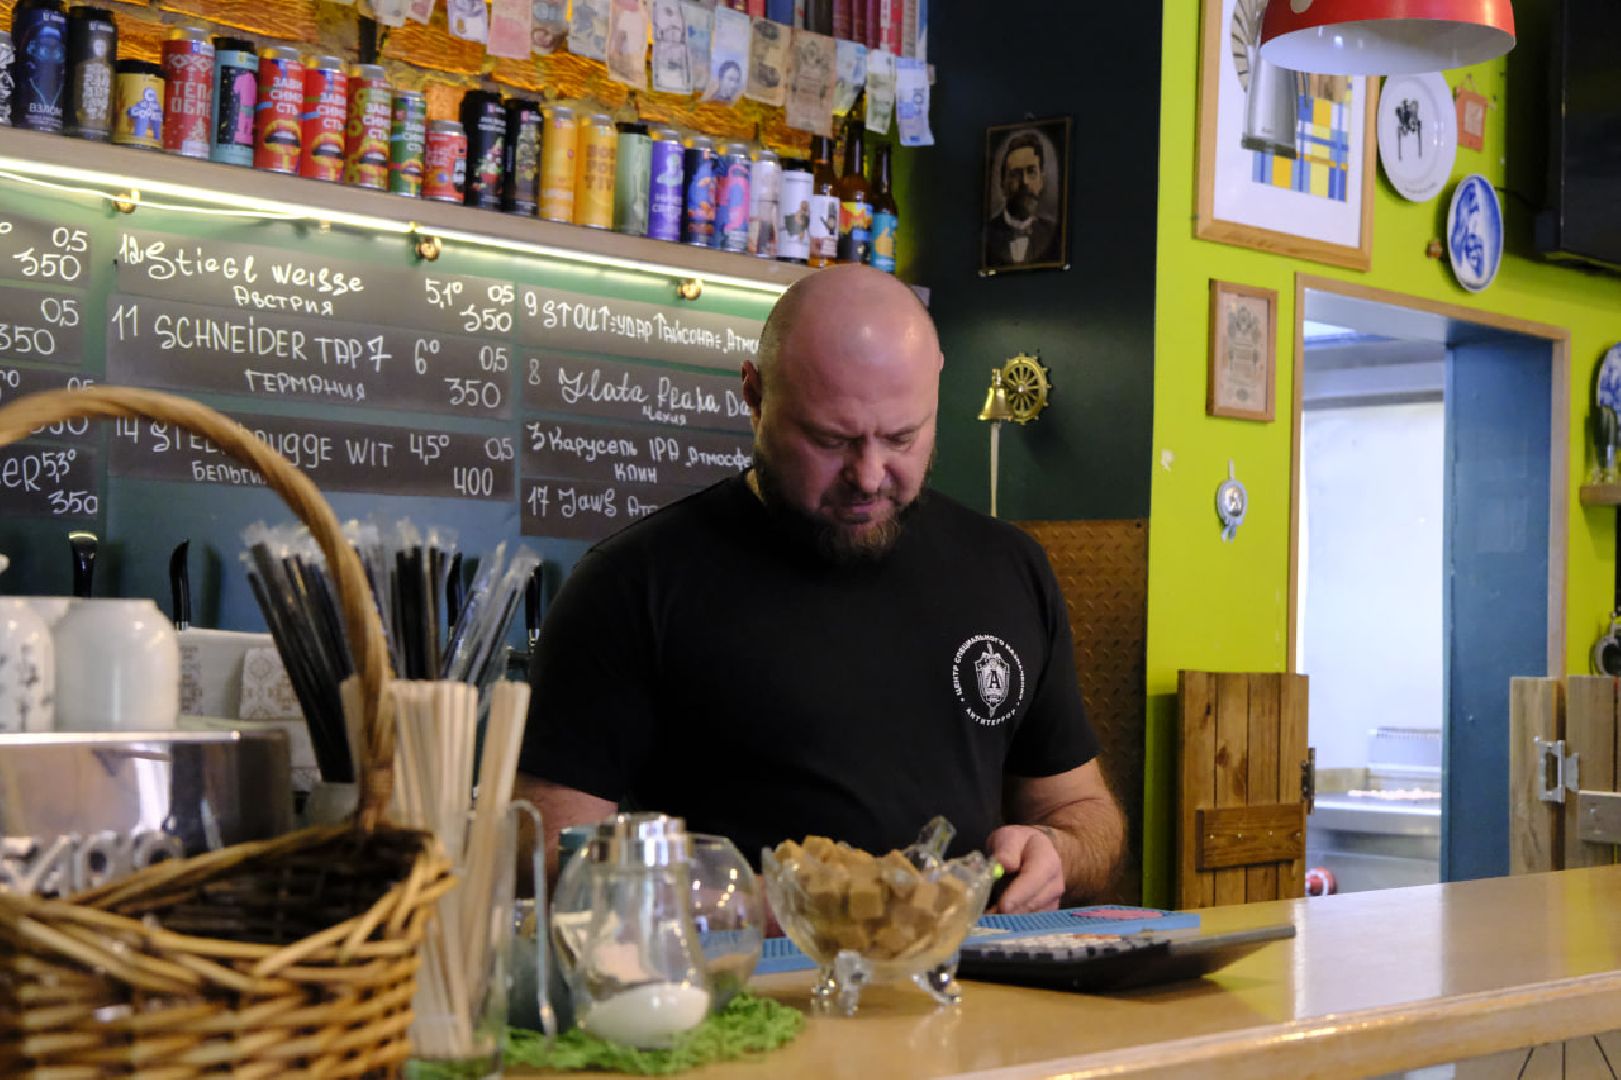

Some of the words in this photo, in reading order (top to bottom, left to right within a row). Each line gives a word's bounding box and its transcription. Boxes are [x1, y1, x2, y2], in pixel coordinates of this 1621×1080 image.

[12, 247, 81, 281] 350
[459, 303, 512, 332] 350
[524, 291, 537, 317] 9
[112, 305, 138, 341] 11
[0, 324, 55, 355] 350
[529, 358, 541, 385] 8
[444, 377, 501, 409] 350
[345, 437, 394, 468] WIT
[648, 436, 679, 462] IPA
[453, 467, 494, 496] 400
[48, 490, 98, 514] 350
[528, 486, 550, 517] 17
